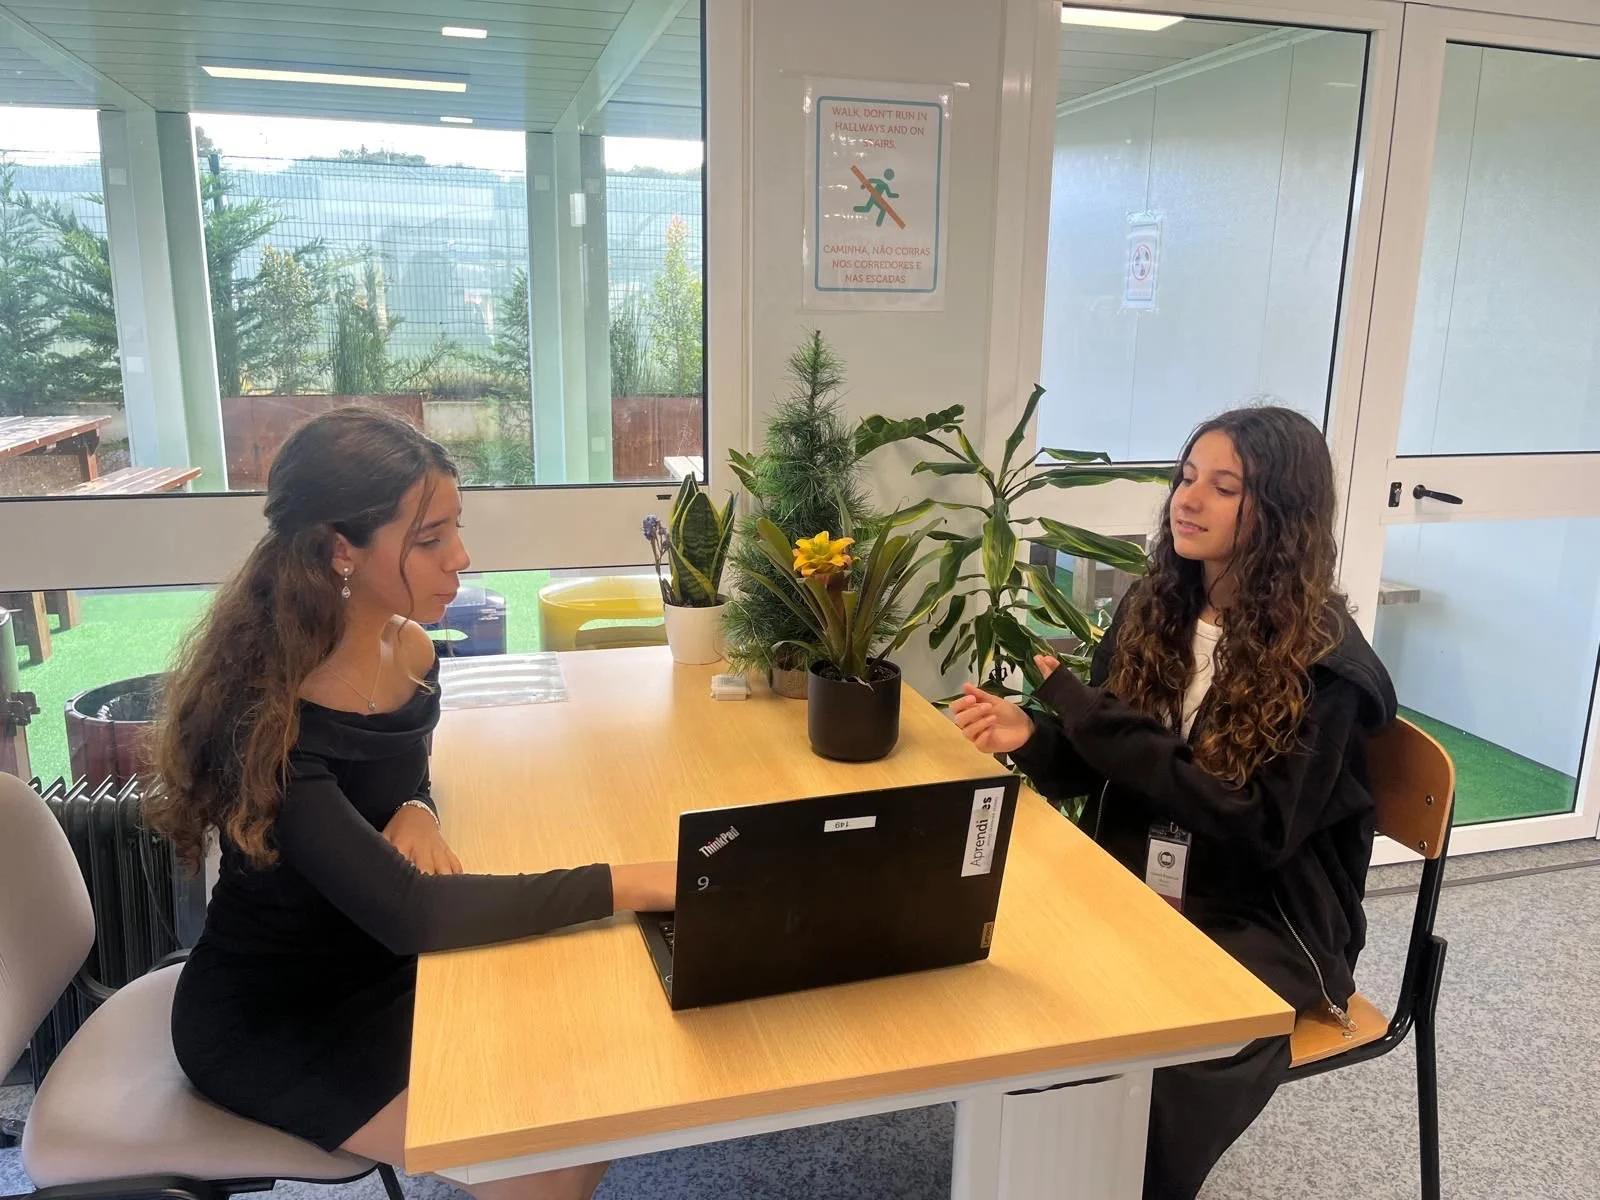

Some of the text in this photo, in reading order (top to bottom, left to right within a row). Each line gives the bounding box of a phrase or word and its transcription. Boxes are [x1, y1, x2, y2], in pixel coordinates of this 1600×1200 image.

[863, 109, 893, 119] DON'T
[895, 110, 915, 120] RUN
[918, 112, 928, 121] IN
[835, 122, 925, 136] HALLWAYS AND ON
[872, 244, 893, 255] NÃO
[894, 247, 931, 256] CORRAS
[832, 260, 922, 270] NOS CORREDORES E
[845, 274, 906, 284] NAS ESCADAS
[969, 796, 993, 868] Aprendies
[698, 825, 741, 857] ThinkPad
